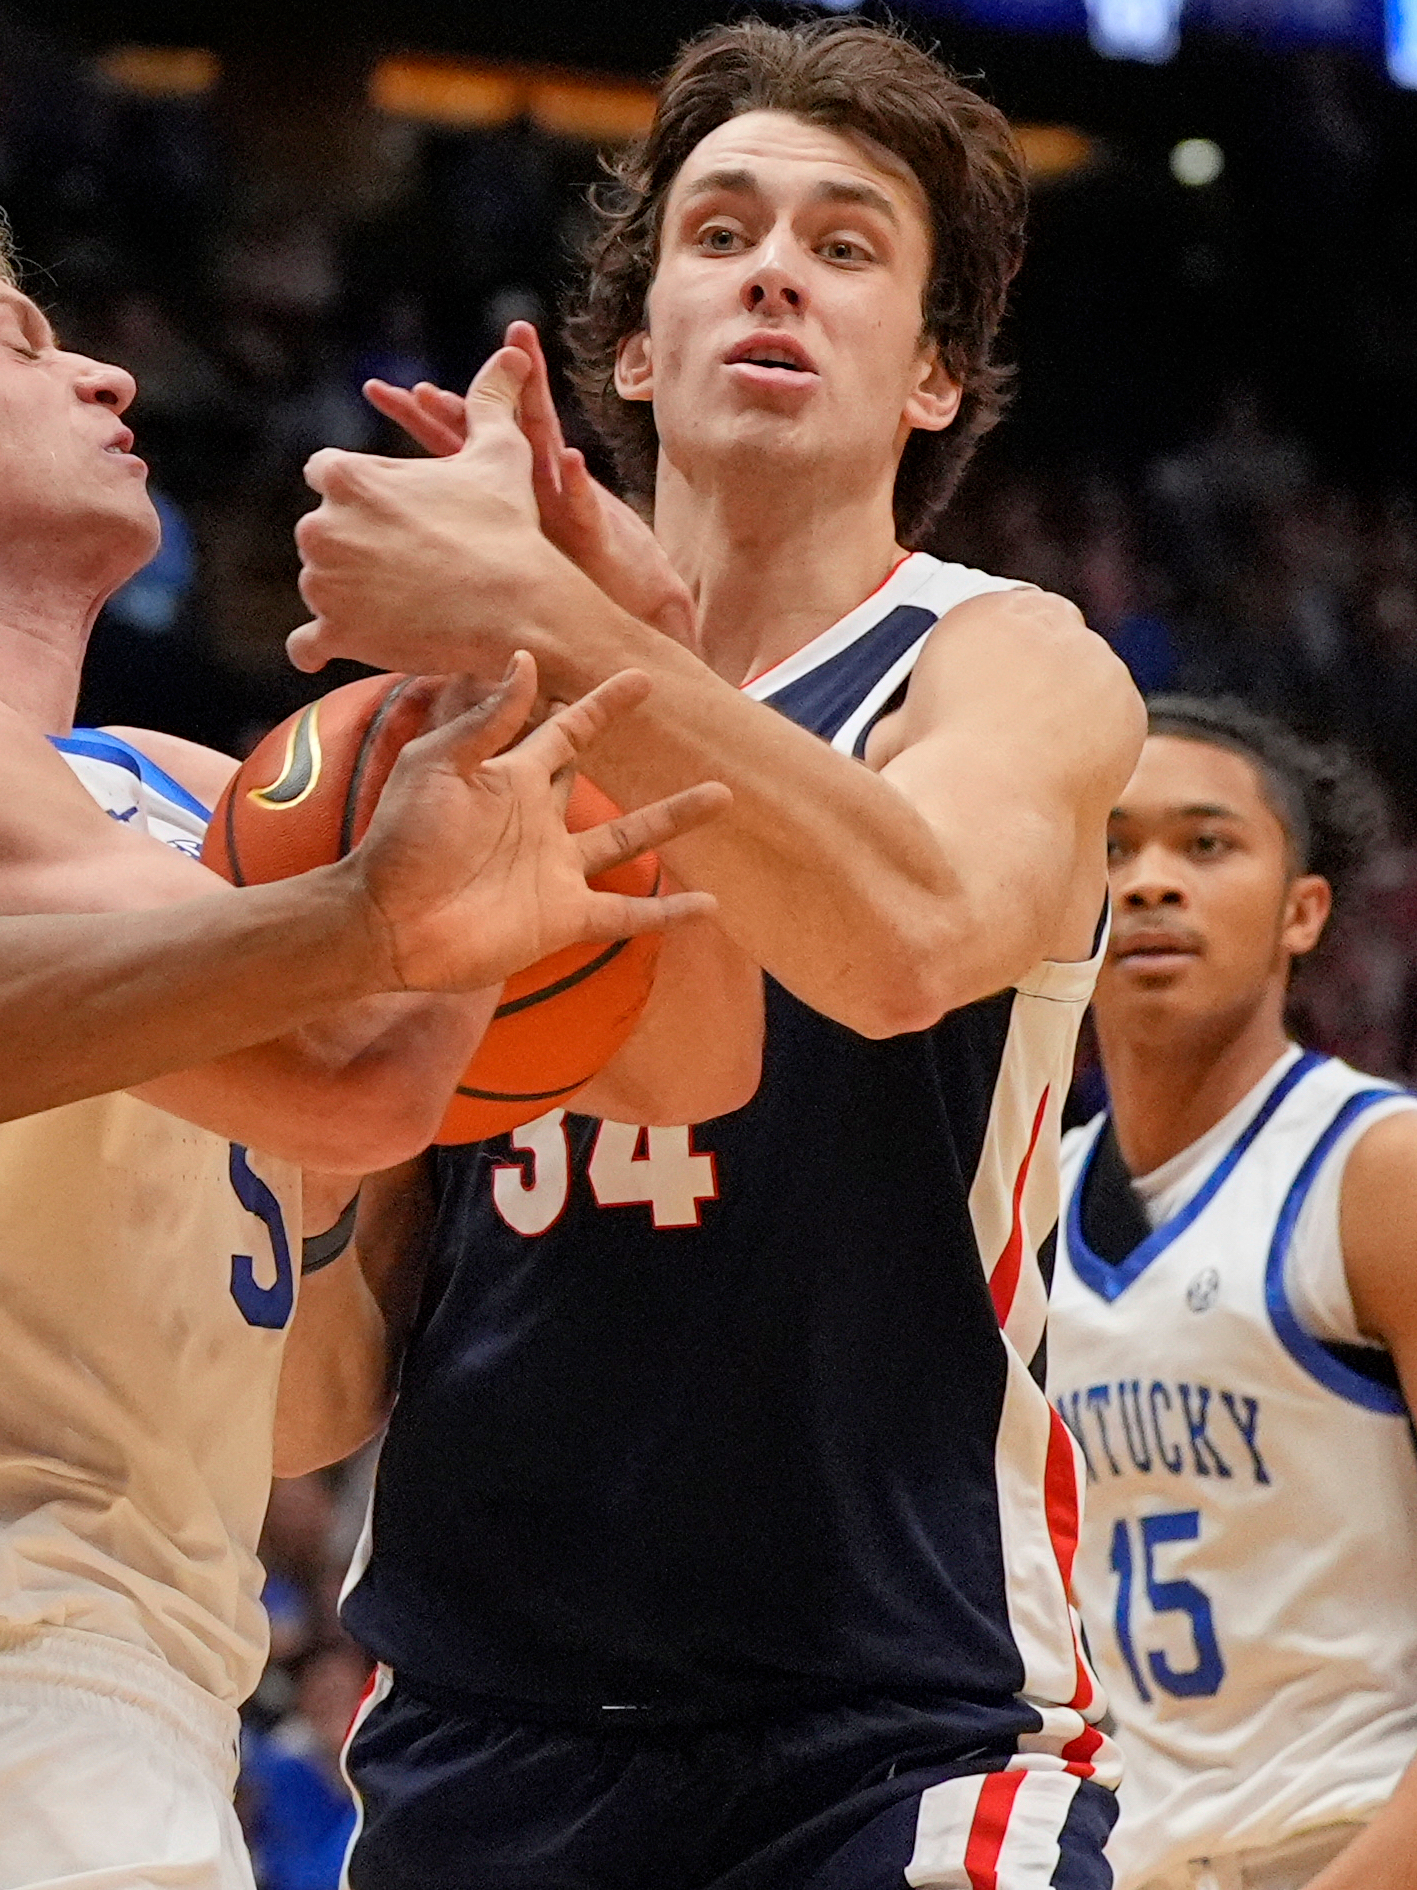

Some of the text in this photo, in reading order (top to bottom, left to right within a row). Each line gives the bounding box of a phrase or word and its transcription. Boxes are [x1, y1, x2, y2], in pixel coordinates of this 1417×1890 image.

[491, 1107, 720, 1238] 34
[1056, 1378, 1271, 1485] NTUCKY
[1109, 1510, 1226, 1703] 15
